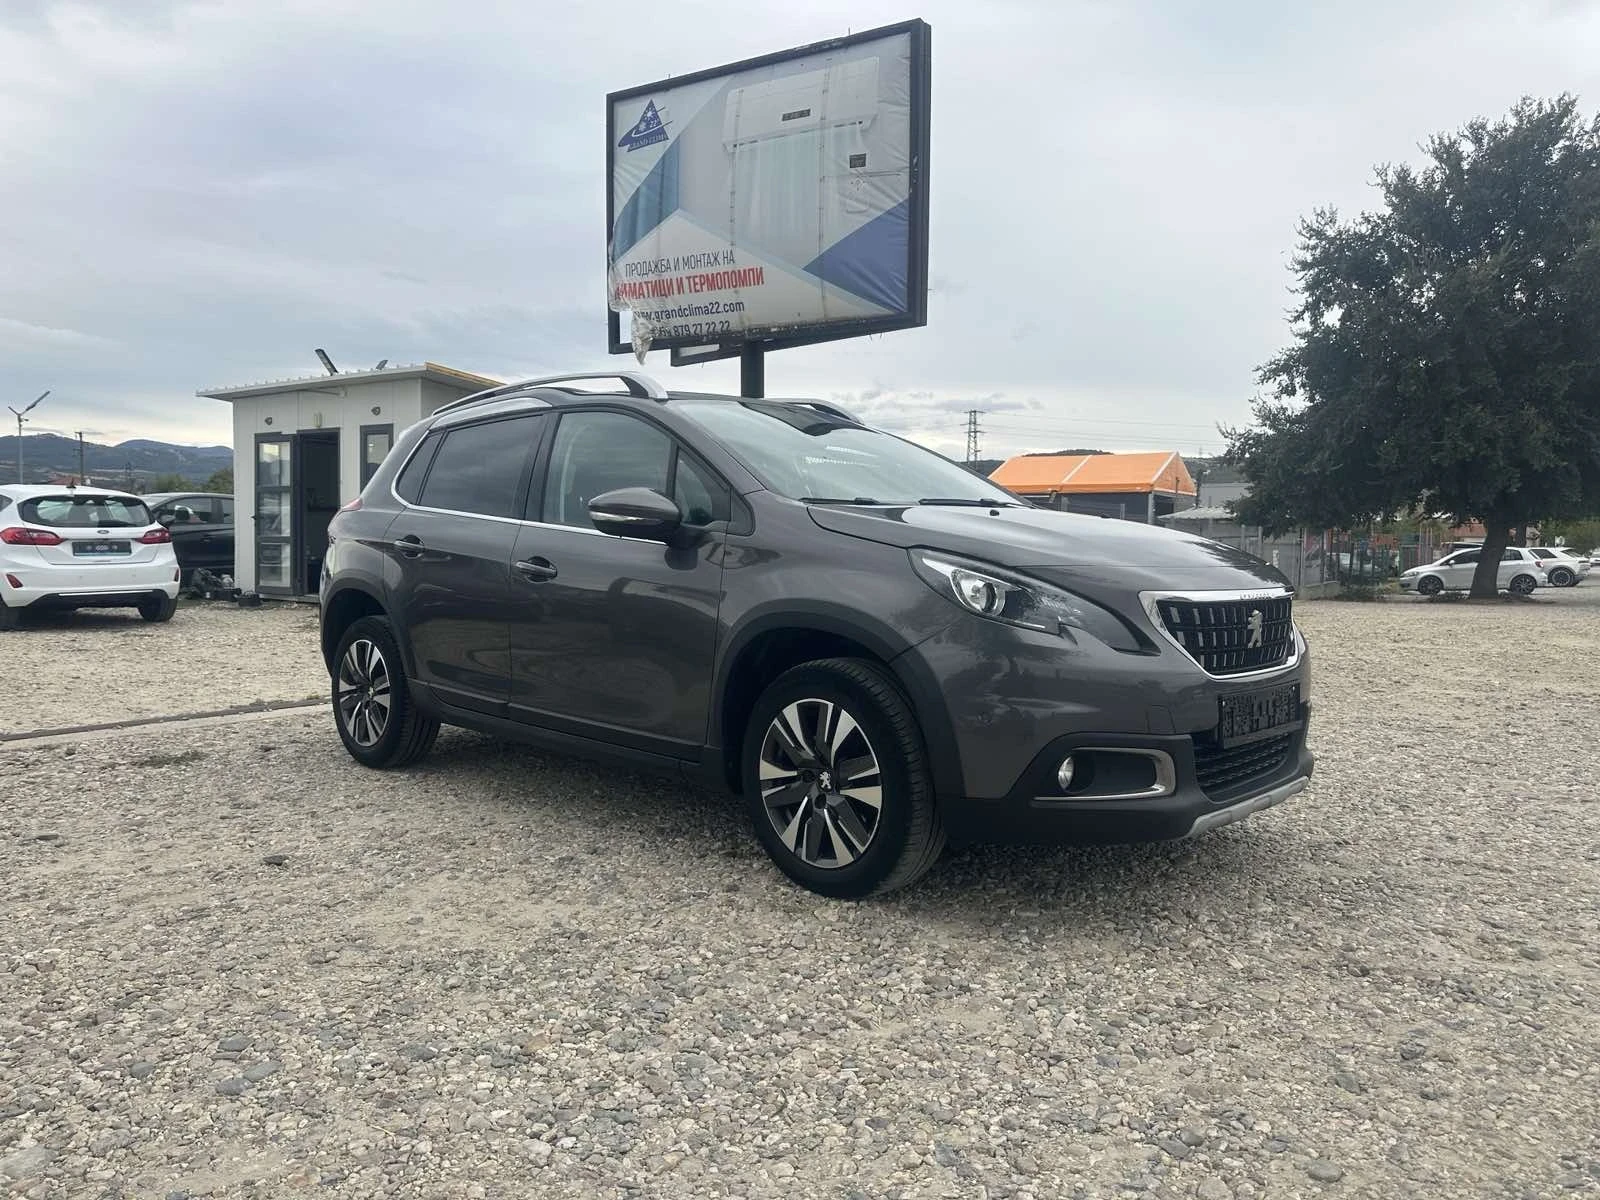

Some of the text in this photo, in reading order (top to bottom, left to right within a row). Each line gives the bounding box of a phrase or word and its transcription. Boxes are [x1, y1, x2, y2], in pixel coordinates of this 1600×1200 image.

[625, 249, 736, 278] ПРОДАЖБА И МОНТАЖ НА
[676, 276, 685, 295] И
[686, 267, 764, 293] ТЕРМОПОМПИ
[673, 323, 691, 337] 879
